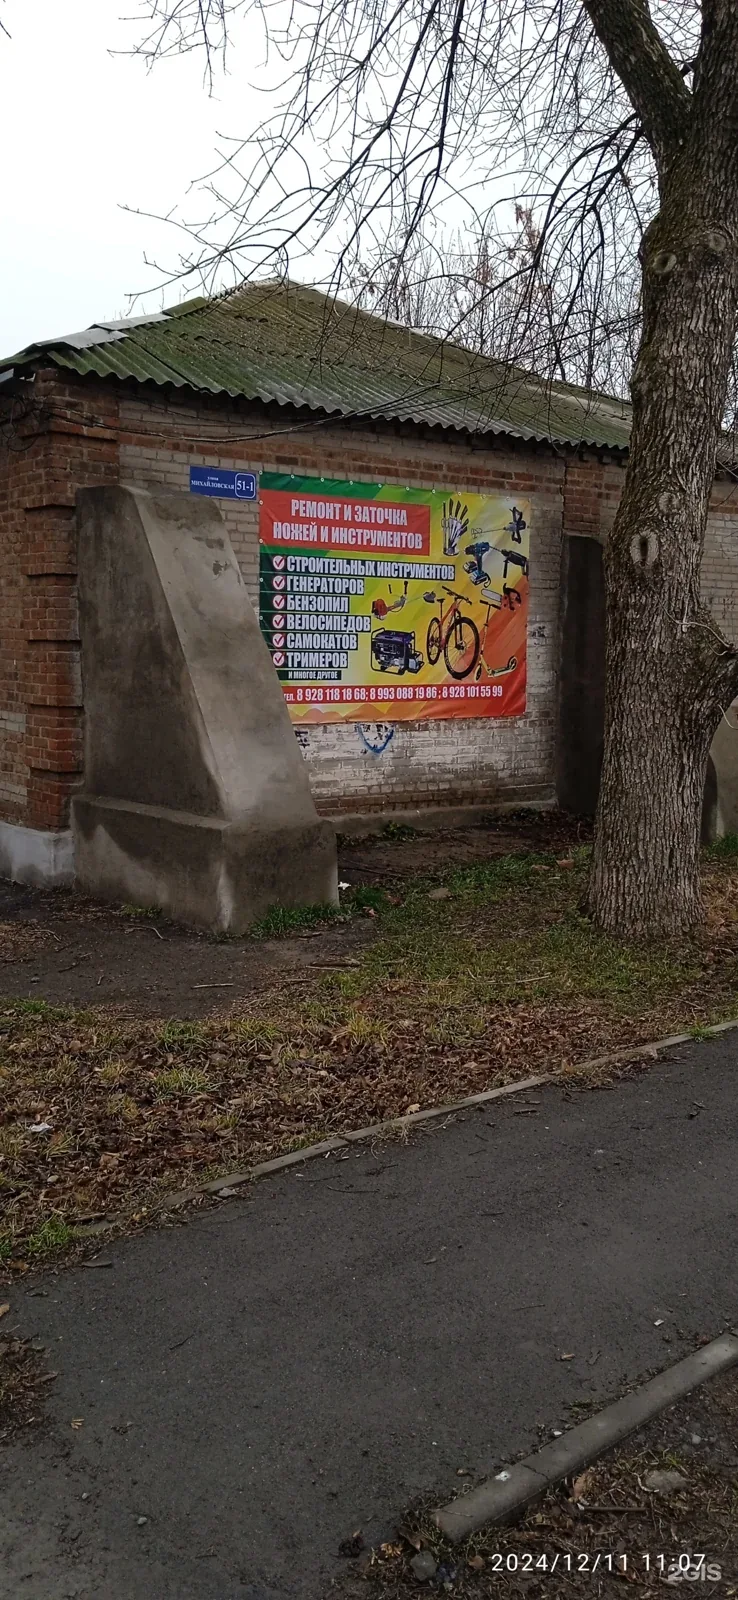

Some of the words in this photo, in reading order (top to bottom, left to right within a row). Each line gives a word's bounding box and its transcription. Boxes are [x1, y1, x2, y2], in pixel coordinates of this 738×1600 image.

[191, 480, 234, 489] МИХАЙЛОВСКАЯ
[237, 481, 253, 491] 51-1
[291, 499, 341, 520] РЕМОНТ
[344, 504, 351, 521] И
[355, 505, 408, 526] ЗАТОЧКА
[273, 522, 317, 542] НОЖЕЙ
[321, 526, 328, 542] И
[331, 527, 422, 549] ИНСТРУМЕНТОВ
[287, 556, 376, 576] СТРОИТЕЛЬНЫХ
[377, 562, 455, 580] ИНСТРУМЕНТОВ
[287, 577, 364, 594] ГЕНЕРАТОРОВ
[287, 596, 349, 612] БЕНЗОПИЛ
[287, 615, 371, 632] ВЕЛОСИПЕДОВ
[287, 634, 357, 649] САМОКАТОВ
[287, 652, 347, 668] ТРИМЕРОВ
[297, 688, 303, 701] 8
[305, 688, 323, 700] 928
[325, 688, 340, 700] 118
[342, 688, 353, 700] 18
[354, 688, 368, 701] 68;
[370, 688, 376, 699] 8
[377, 688, 394, 699] 993
[396, 687, 413, 699] 088
[415, 687, 424, 699] 19
[426, 687, 437, 698] 86
[442, 687, 448, 698] 8
[449, 686, 465, 698] 928
[466, 686, 479, 697] 101
[480, 686, 490, 697] 55
[492, 685, 502, 697] 99
